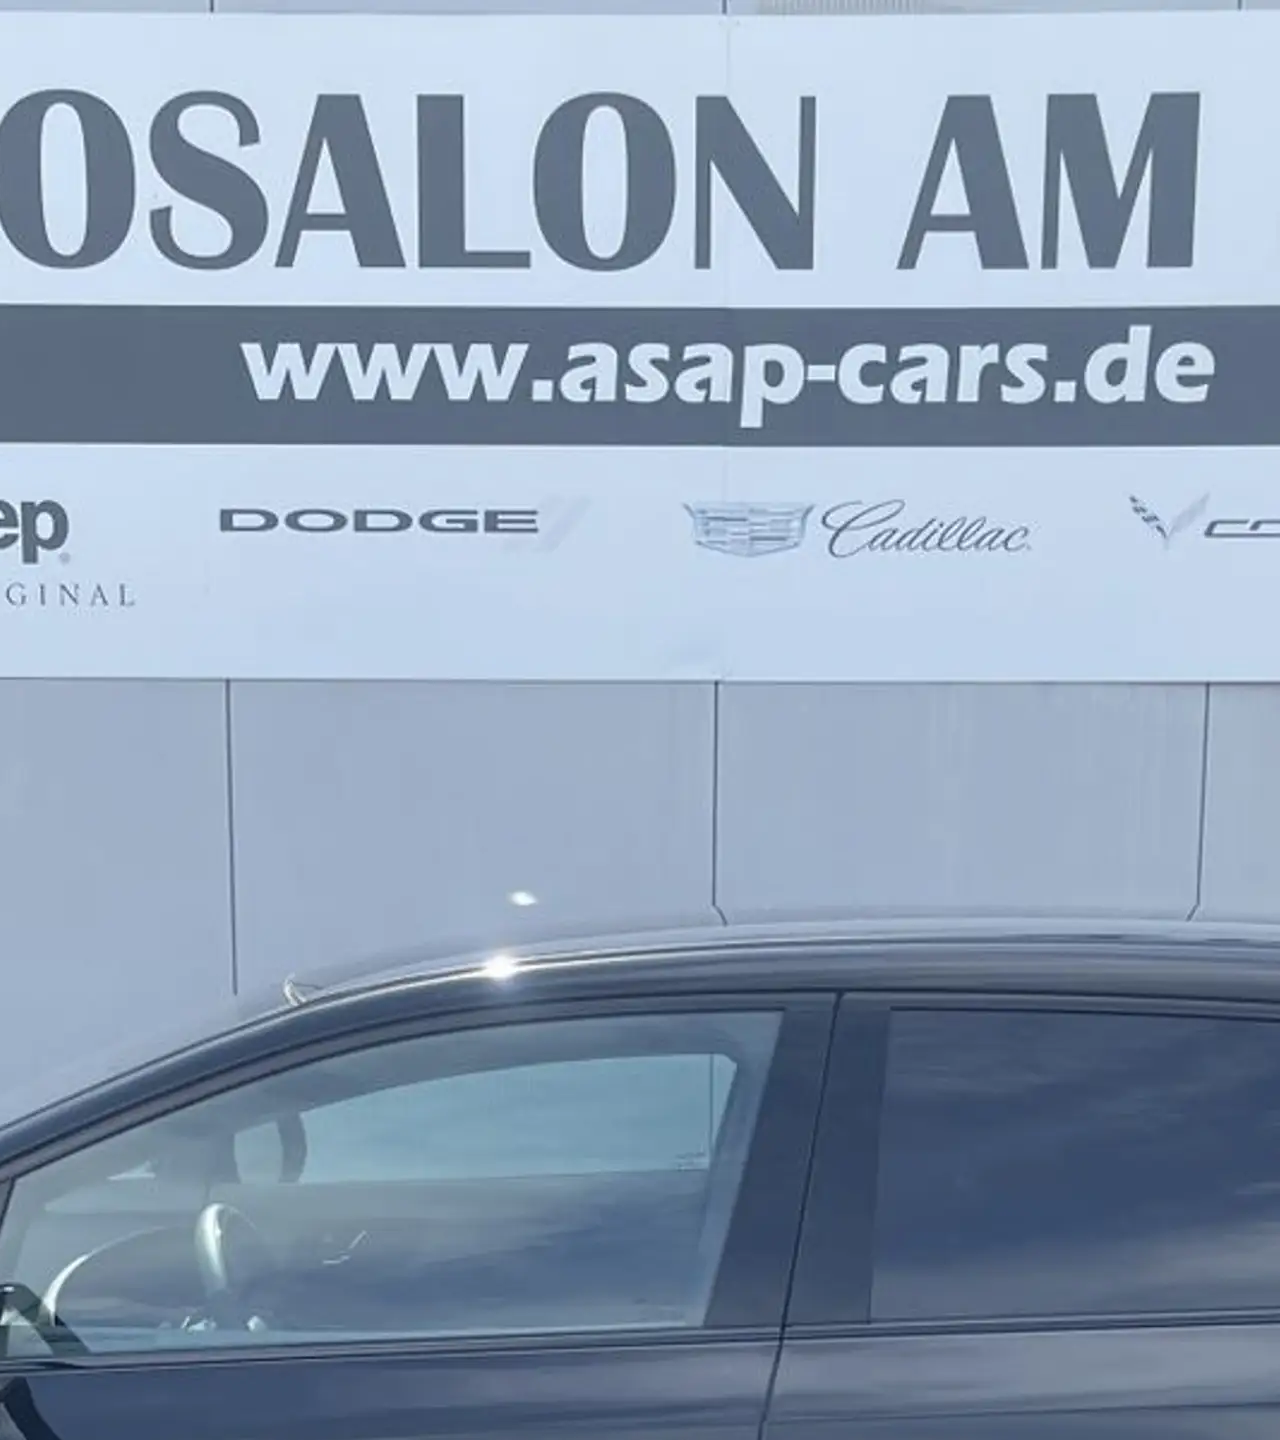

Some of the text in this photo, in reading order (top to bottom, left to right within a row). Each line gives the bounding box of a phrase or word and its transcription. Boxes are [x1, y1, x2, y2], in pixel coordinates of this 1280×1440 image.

[896, 91, 1201, 270] AM
[240, 324, 1215, 429] www.asap-cars.de
[219, 507, 539, 533] DODGE
[820, 499, 1030, 559] Cadillac
